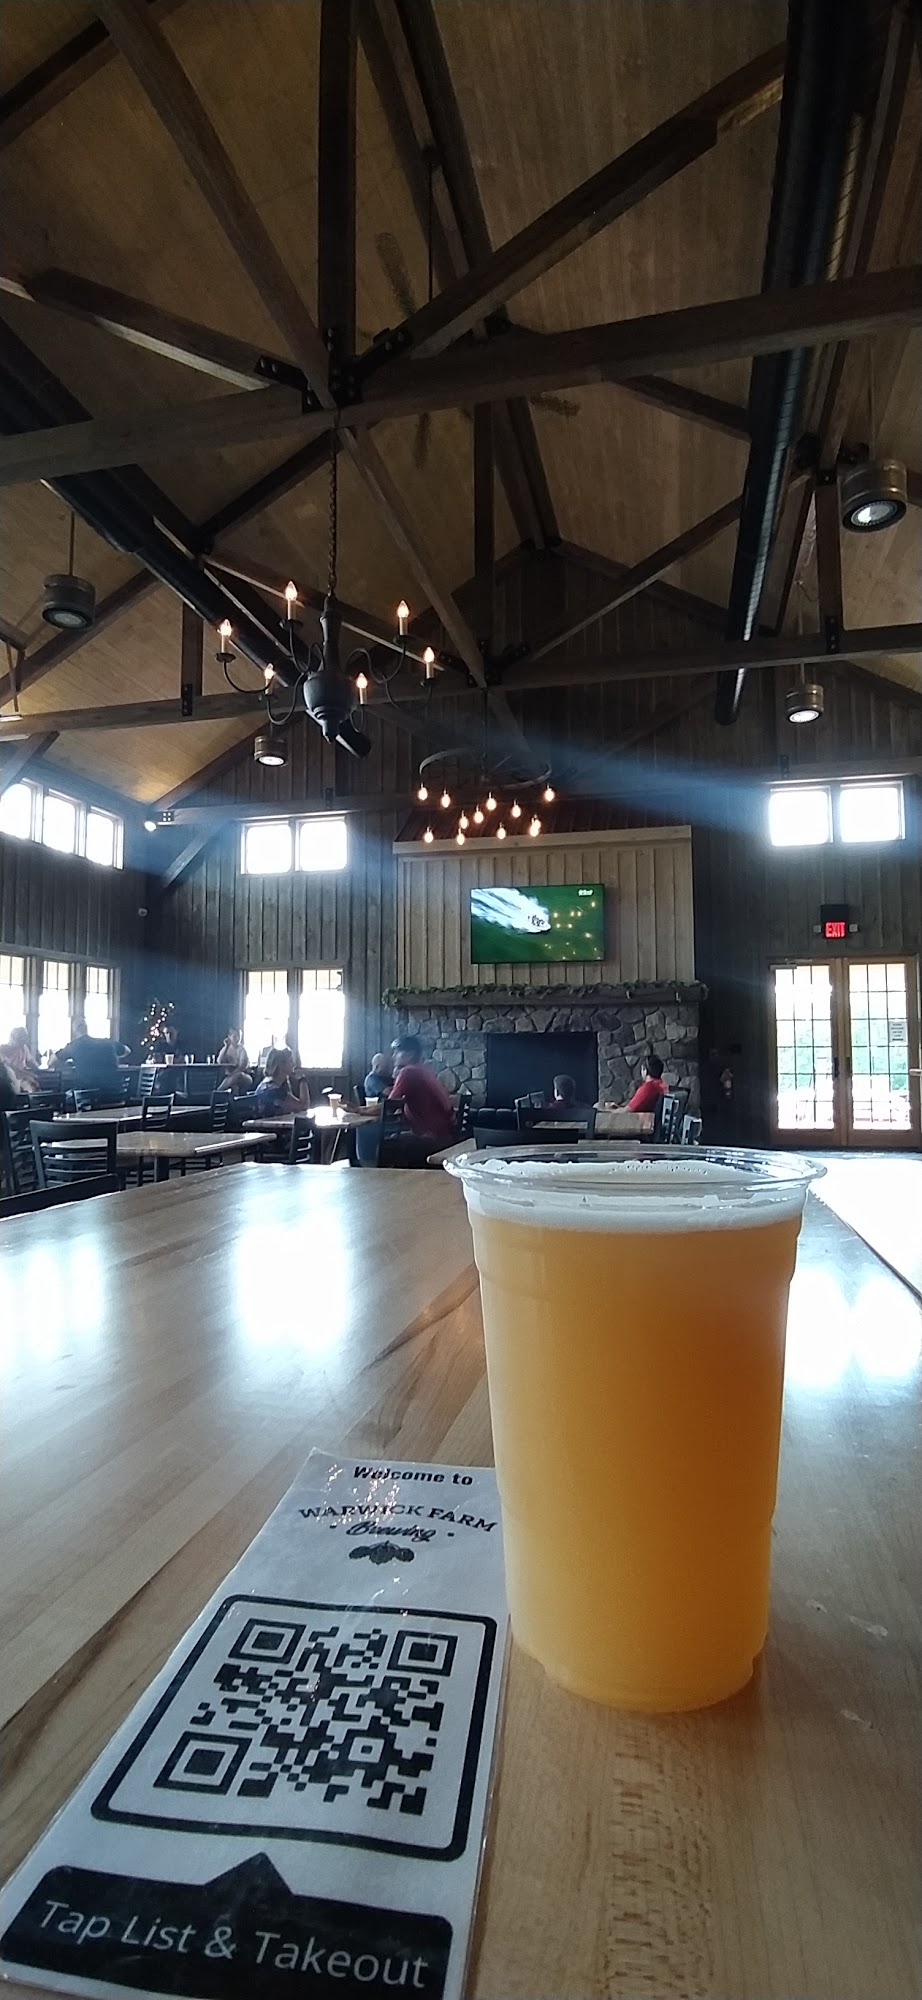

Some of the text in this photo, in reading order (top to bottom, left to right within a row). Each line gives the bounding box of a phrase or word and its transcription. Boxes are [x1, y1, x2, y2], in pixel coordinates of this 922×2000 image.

[825, 922, 845, 938] EXIT
[353, 1466, 473, 1486] Welcome to
[299, 1504, 498, 1532] WARWICK FARM
[346, 1521, 436, 1542] Brewing
[37, 1900, 429, 1988] Tap List & Takeout
